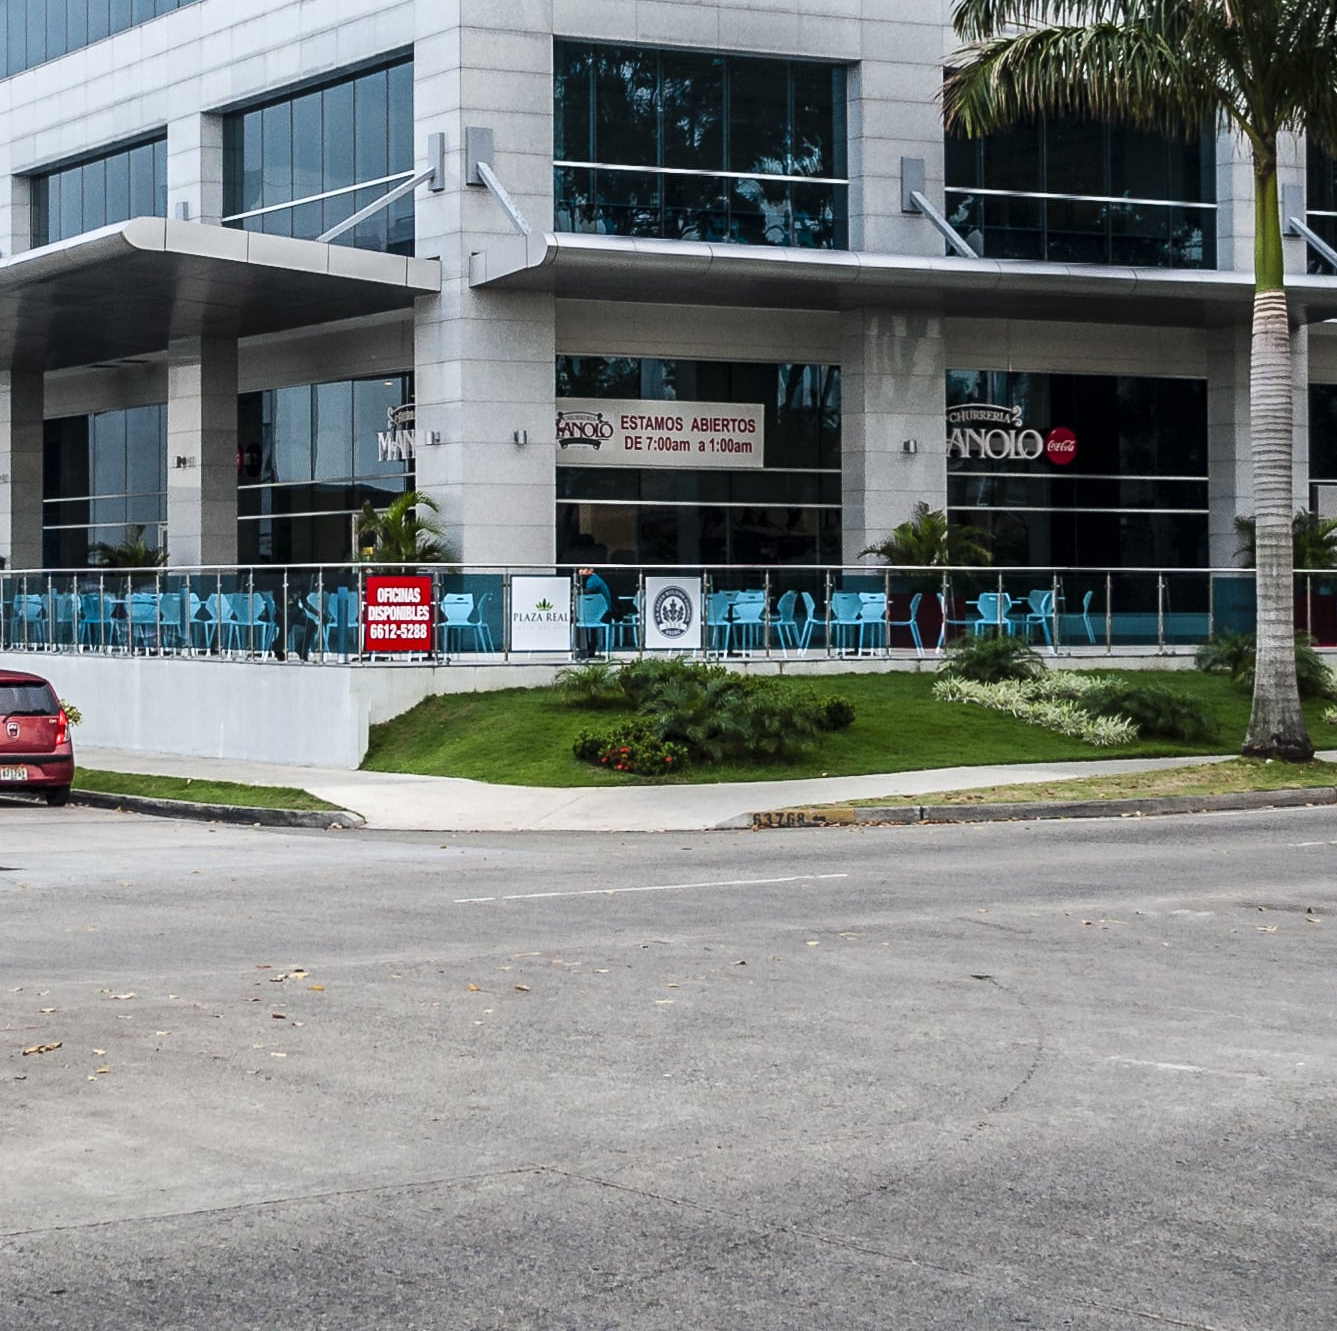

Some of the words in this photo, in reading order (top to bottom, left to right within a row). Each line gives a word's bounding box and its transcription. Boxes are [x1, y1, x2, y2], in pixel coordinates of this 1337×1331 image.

[620, 415, 684, 432] ESTAMOS
[691, 417, 756, 434] ABIERTOS
[377, 430, 416, 462] MAN
[624, 436, 643, 451] DE
[646, 437, 691, 452] 7:00am
[698, 440, 706, 453] a
[709, 438, 753, 454] 1:00am
[946, 428, 1044, 460] ANOLO
[377, 587, 422, 603] OFICINAS
[367, 605, 430, 621] DISPONIBLES
[513, 612, 543, 622] PLAZA
[546, 612, 569, 622] REAL
[369, 623, 428, 639] 6612-5288
